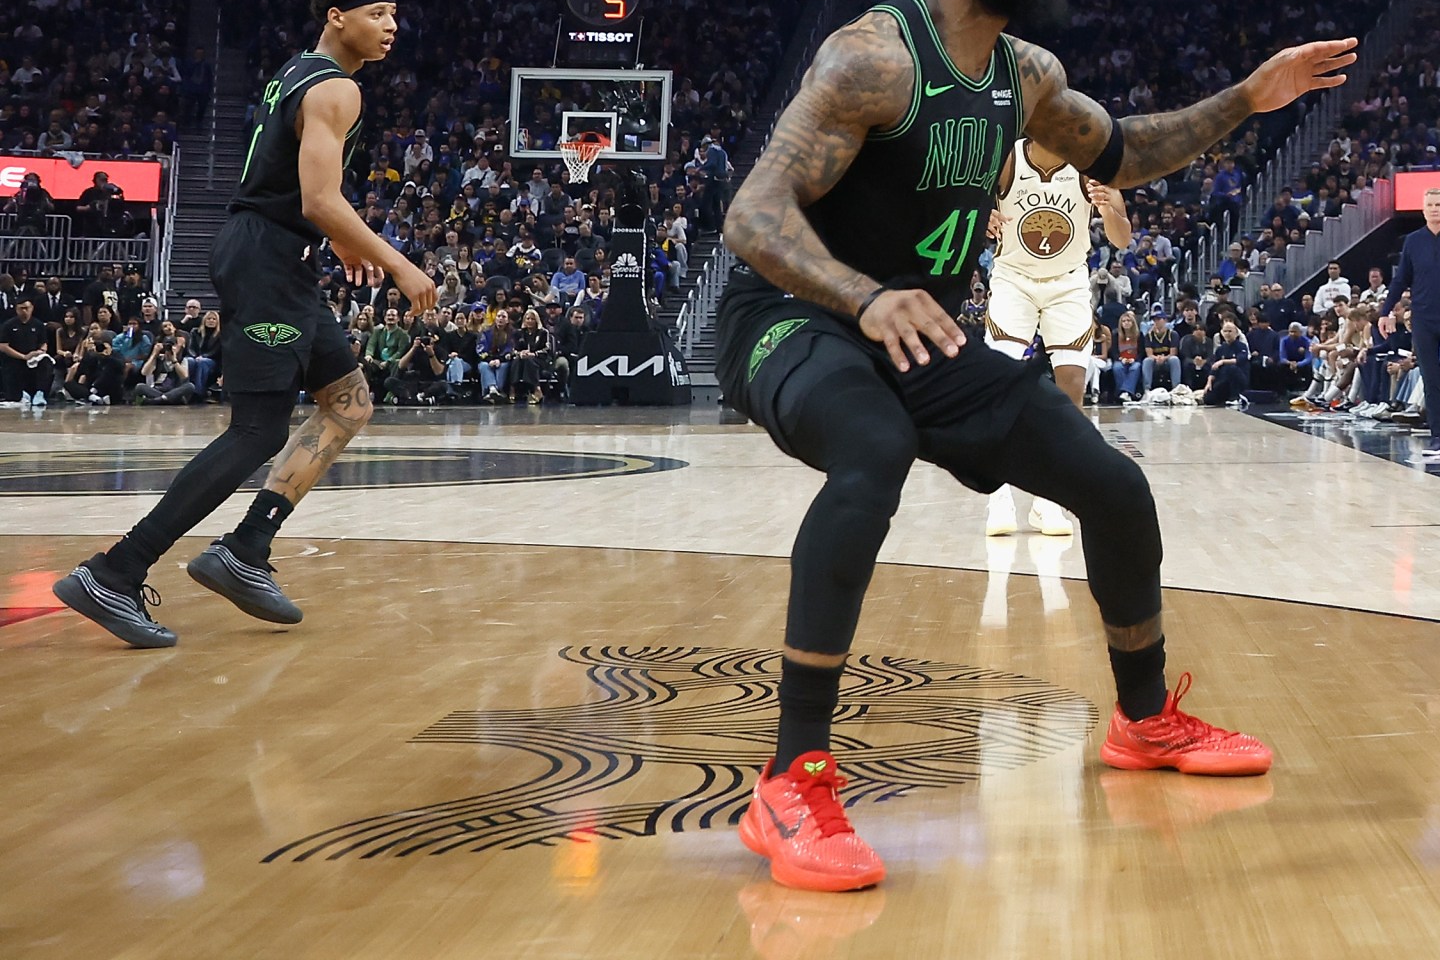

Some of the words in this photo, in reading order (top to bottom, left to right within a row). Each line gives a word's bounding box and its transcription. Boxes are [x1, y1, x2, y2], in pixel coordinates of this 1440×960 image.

[586, 32, 633, 42] TISSOT
[917, 118, 1003, 196] NOLA
[1013, 191, 1077, 214] TOWN
[915, 210, 979, 275] 41
[1038, 237, 1051, 254] 4
[577, 355, 664, 377] KIA
